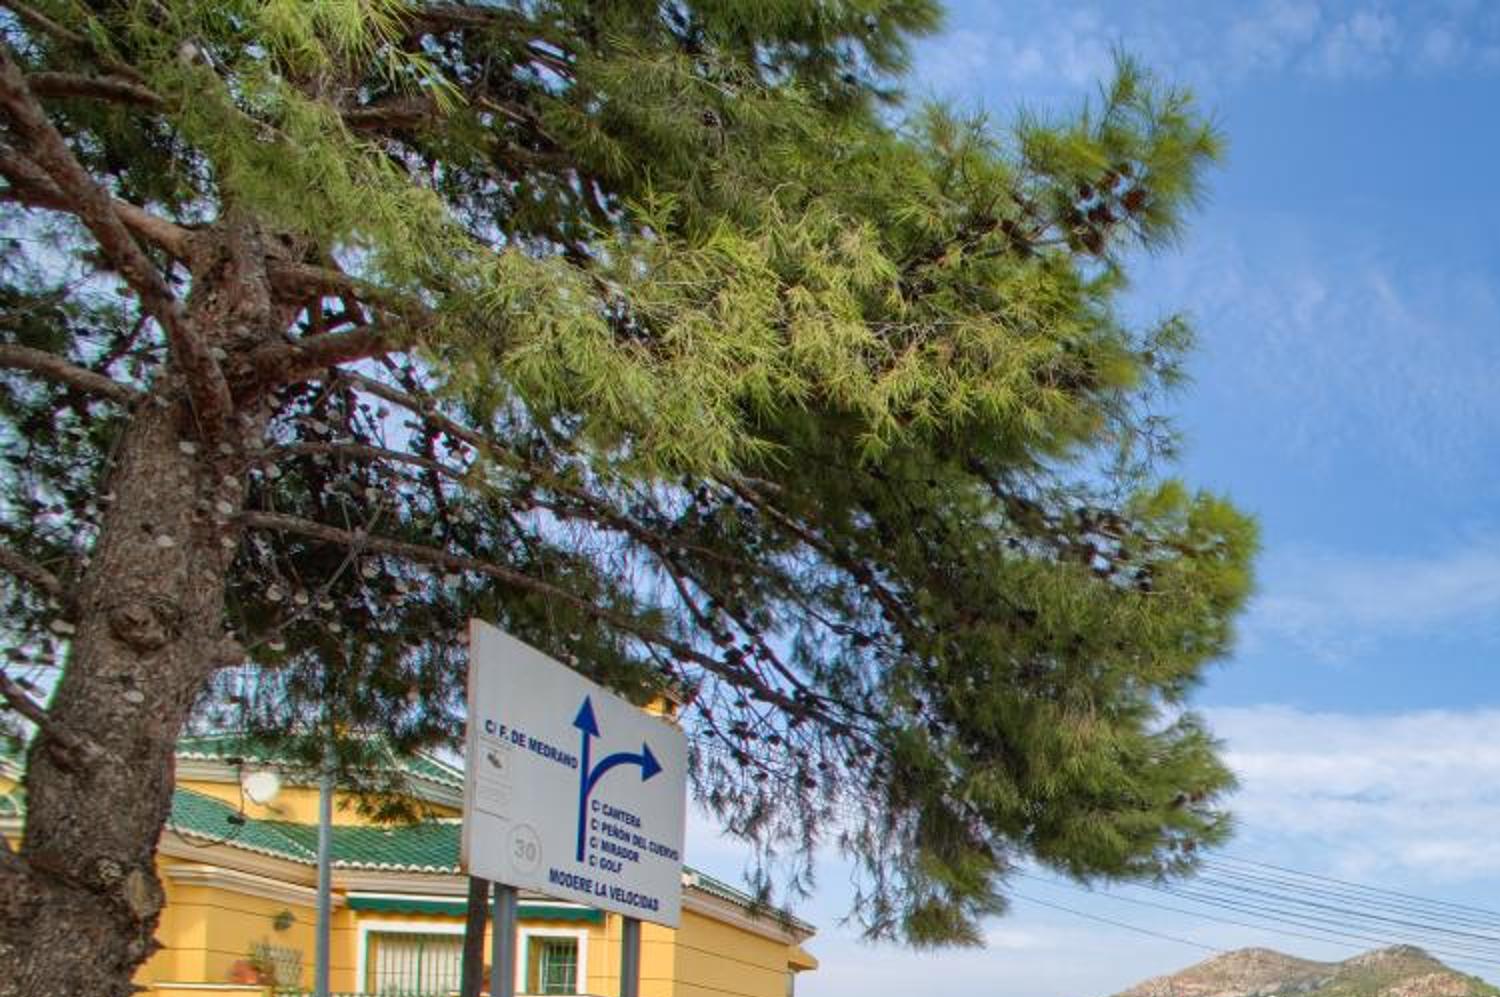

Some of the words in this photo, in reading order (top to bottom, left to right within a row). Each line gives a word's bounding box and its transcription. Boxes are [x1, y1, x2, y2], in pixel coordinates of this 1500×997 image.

[511, 729, 526, 748] DE
[528, 737, 578, 769] MEDRANO
[602, 803, 641, 828] CANTERA
[513, 837, 537, 863] 30
[601, 839, 639, 863] MIRADOR
[632, 833, 647, 850] DEL
[649, 840, 679, 861] CUERVO
[600, 857, 623, 874] GOLF
[549, 867, 592, 894] MODERE
[595, 881, 607, 897] LA
[609, 884, 660, 912] VELOCIDAD
